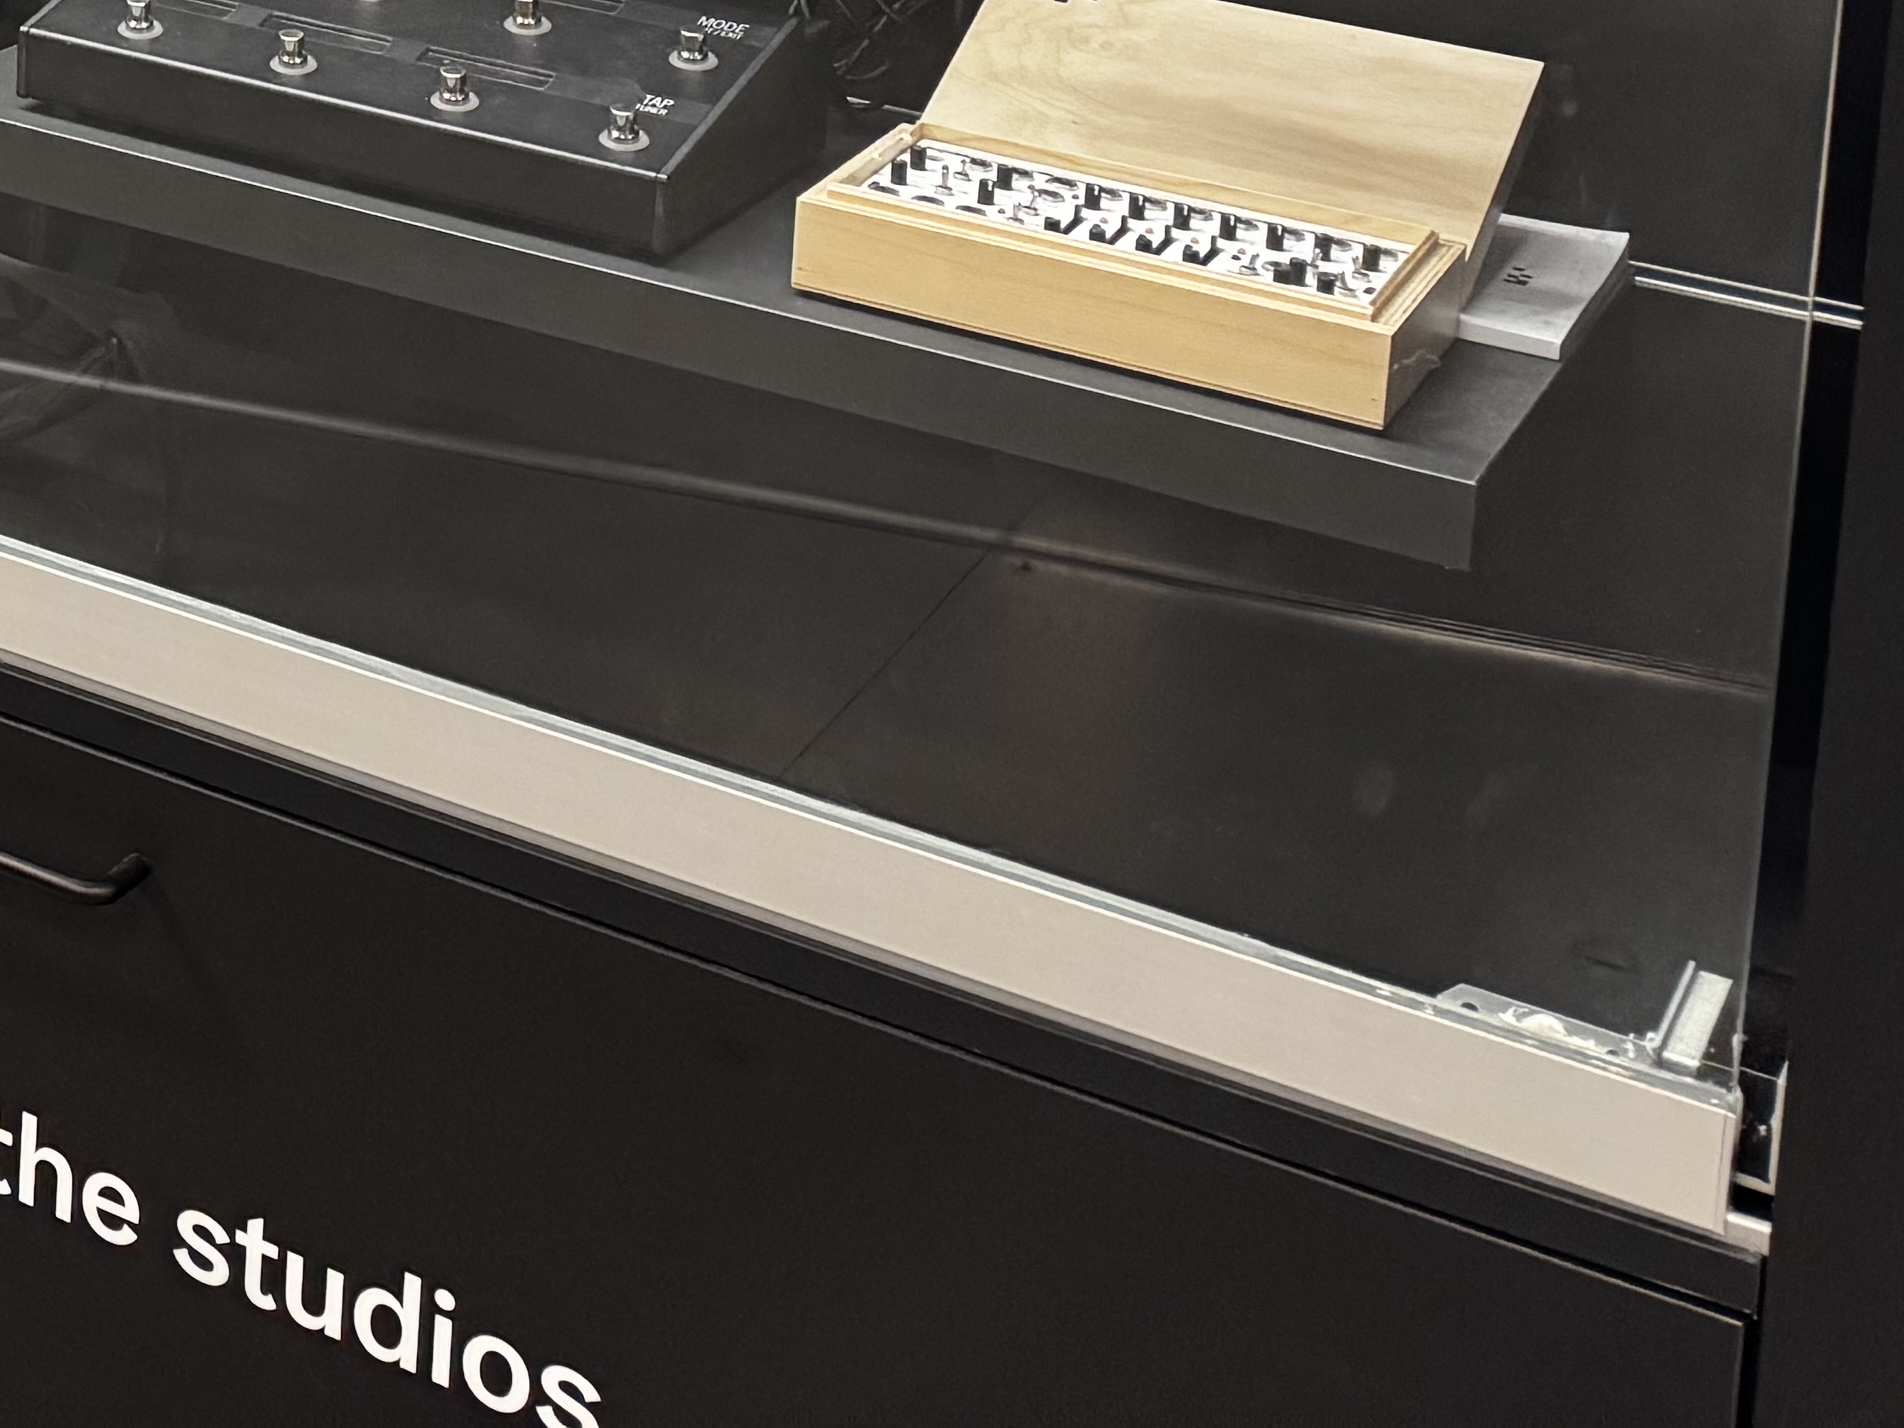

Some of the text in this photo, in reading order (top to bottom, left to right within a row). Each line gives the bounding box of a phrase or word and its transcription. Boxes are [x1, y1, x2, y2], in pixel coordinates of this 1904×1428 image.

[697, 16, 750, 34] MODE
[643, 94, 675, 109] TAP
[172, 1209, 602, 1428] studios
